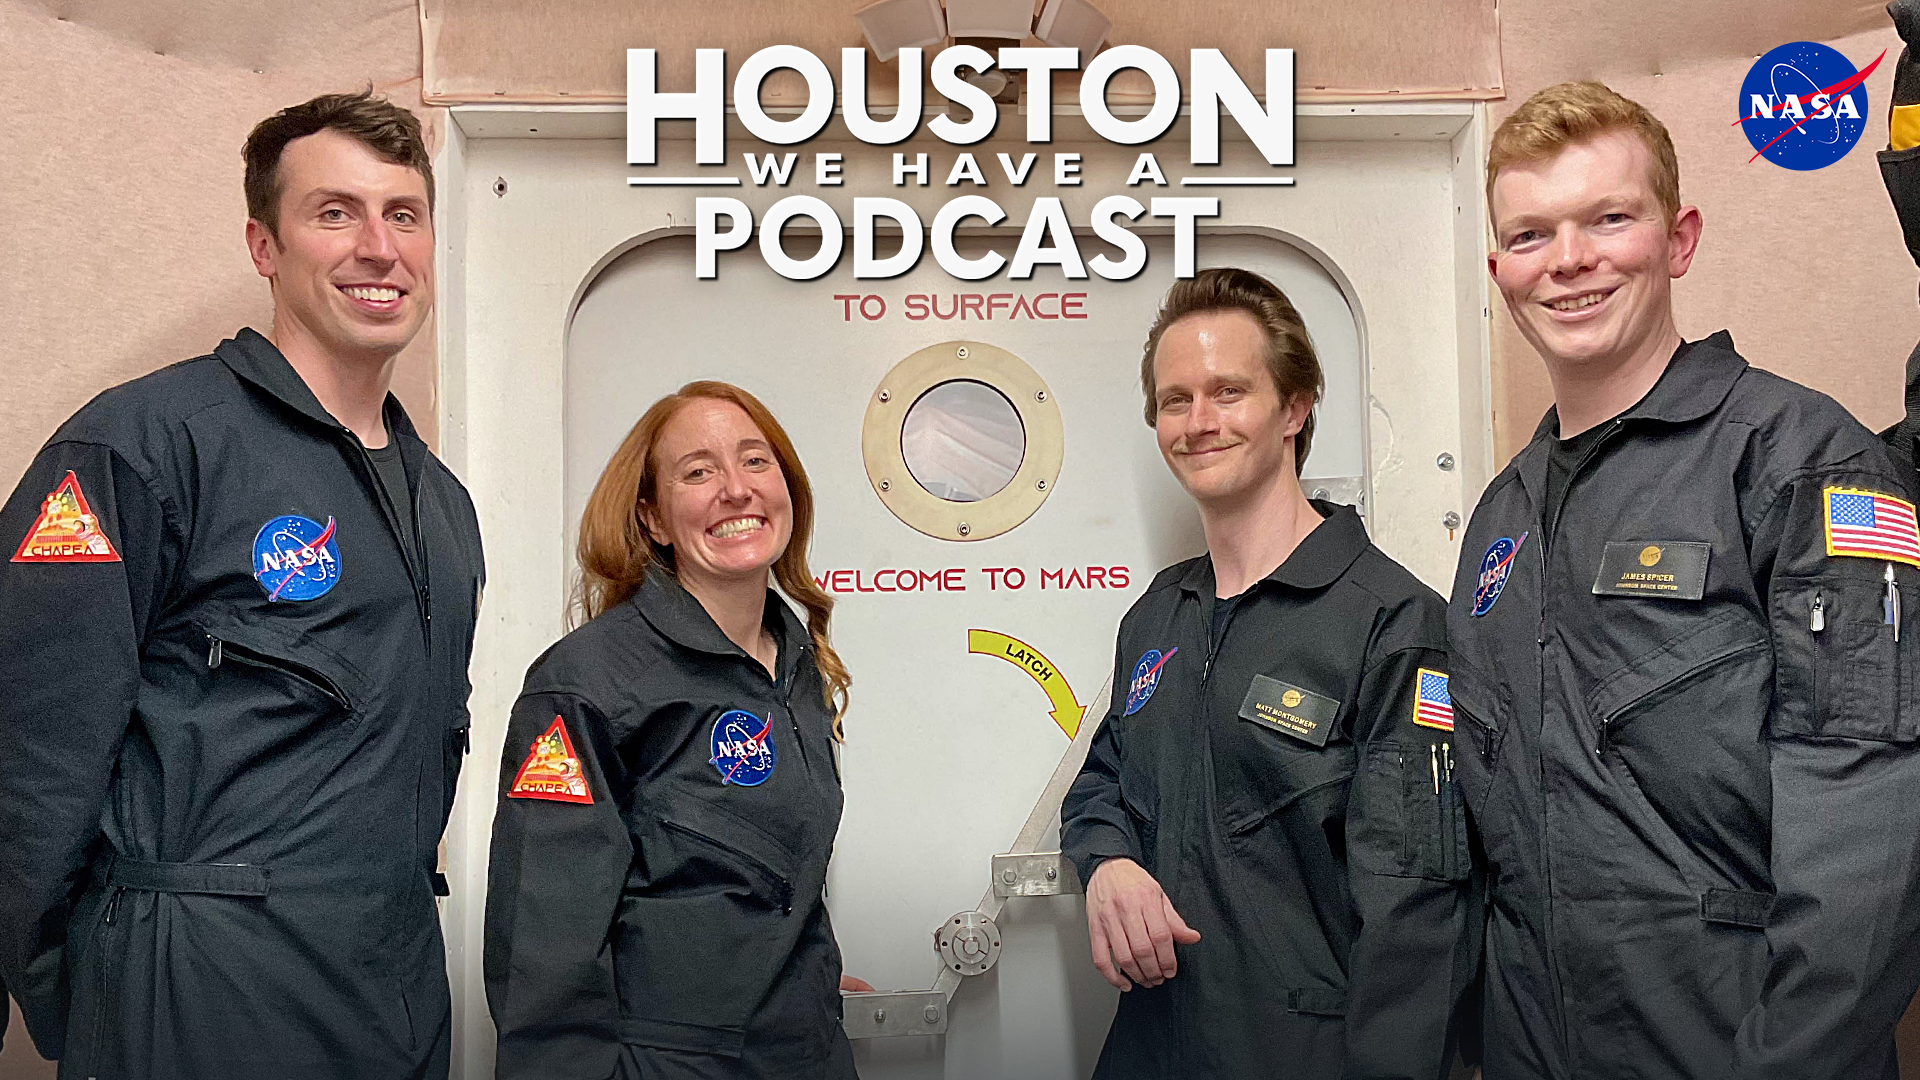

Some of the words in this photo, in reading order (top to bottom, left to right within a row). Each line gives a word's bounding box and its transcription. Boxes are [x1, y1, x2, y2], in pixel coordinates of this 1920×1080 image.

[834, 294, 886, 321] TO
[904, 292, 1088, 320] SURFACE
[31, 545, 93, 556] CHAPEA
[262, 547, 334, 572] NASA
[982, 568, 1025, 590] TO
[1041, 566, 1130, 589] MARS
[1478, 567, 1506, 589] NASA
[1621, 572, 1647, 581] JAMES
[1646, 573, 1674, 582] SPICER
[1005, 643, 1053, 682] LATCH
[1130, 672, 1156, 693] NASA
[1255, 703, 1273, 715] MATT
[1272, 708, 1317, 729] MONTGOMERY
[718, 740, 771, 758] NASA
[521, 782, 571, 795] CHAPEA
